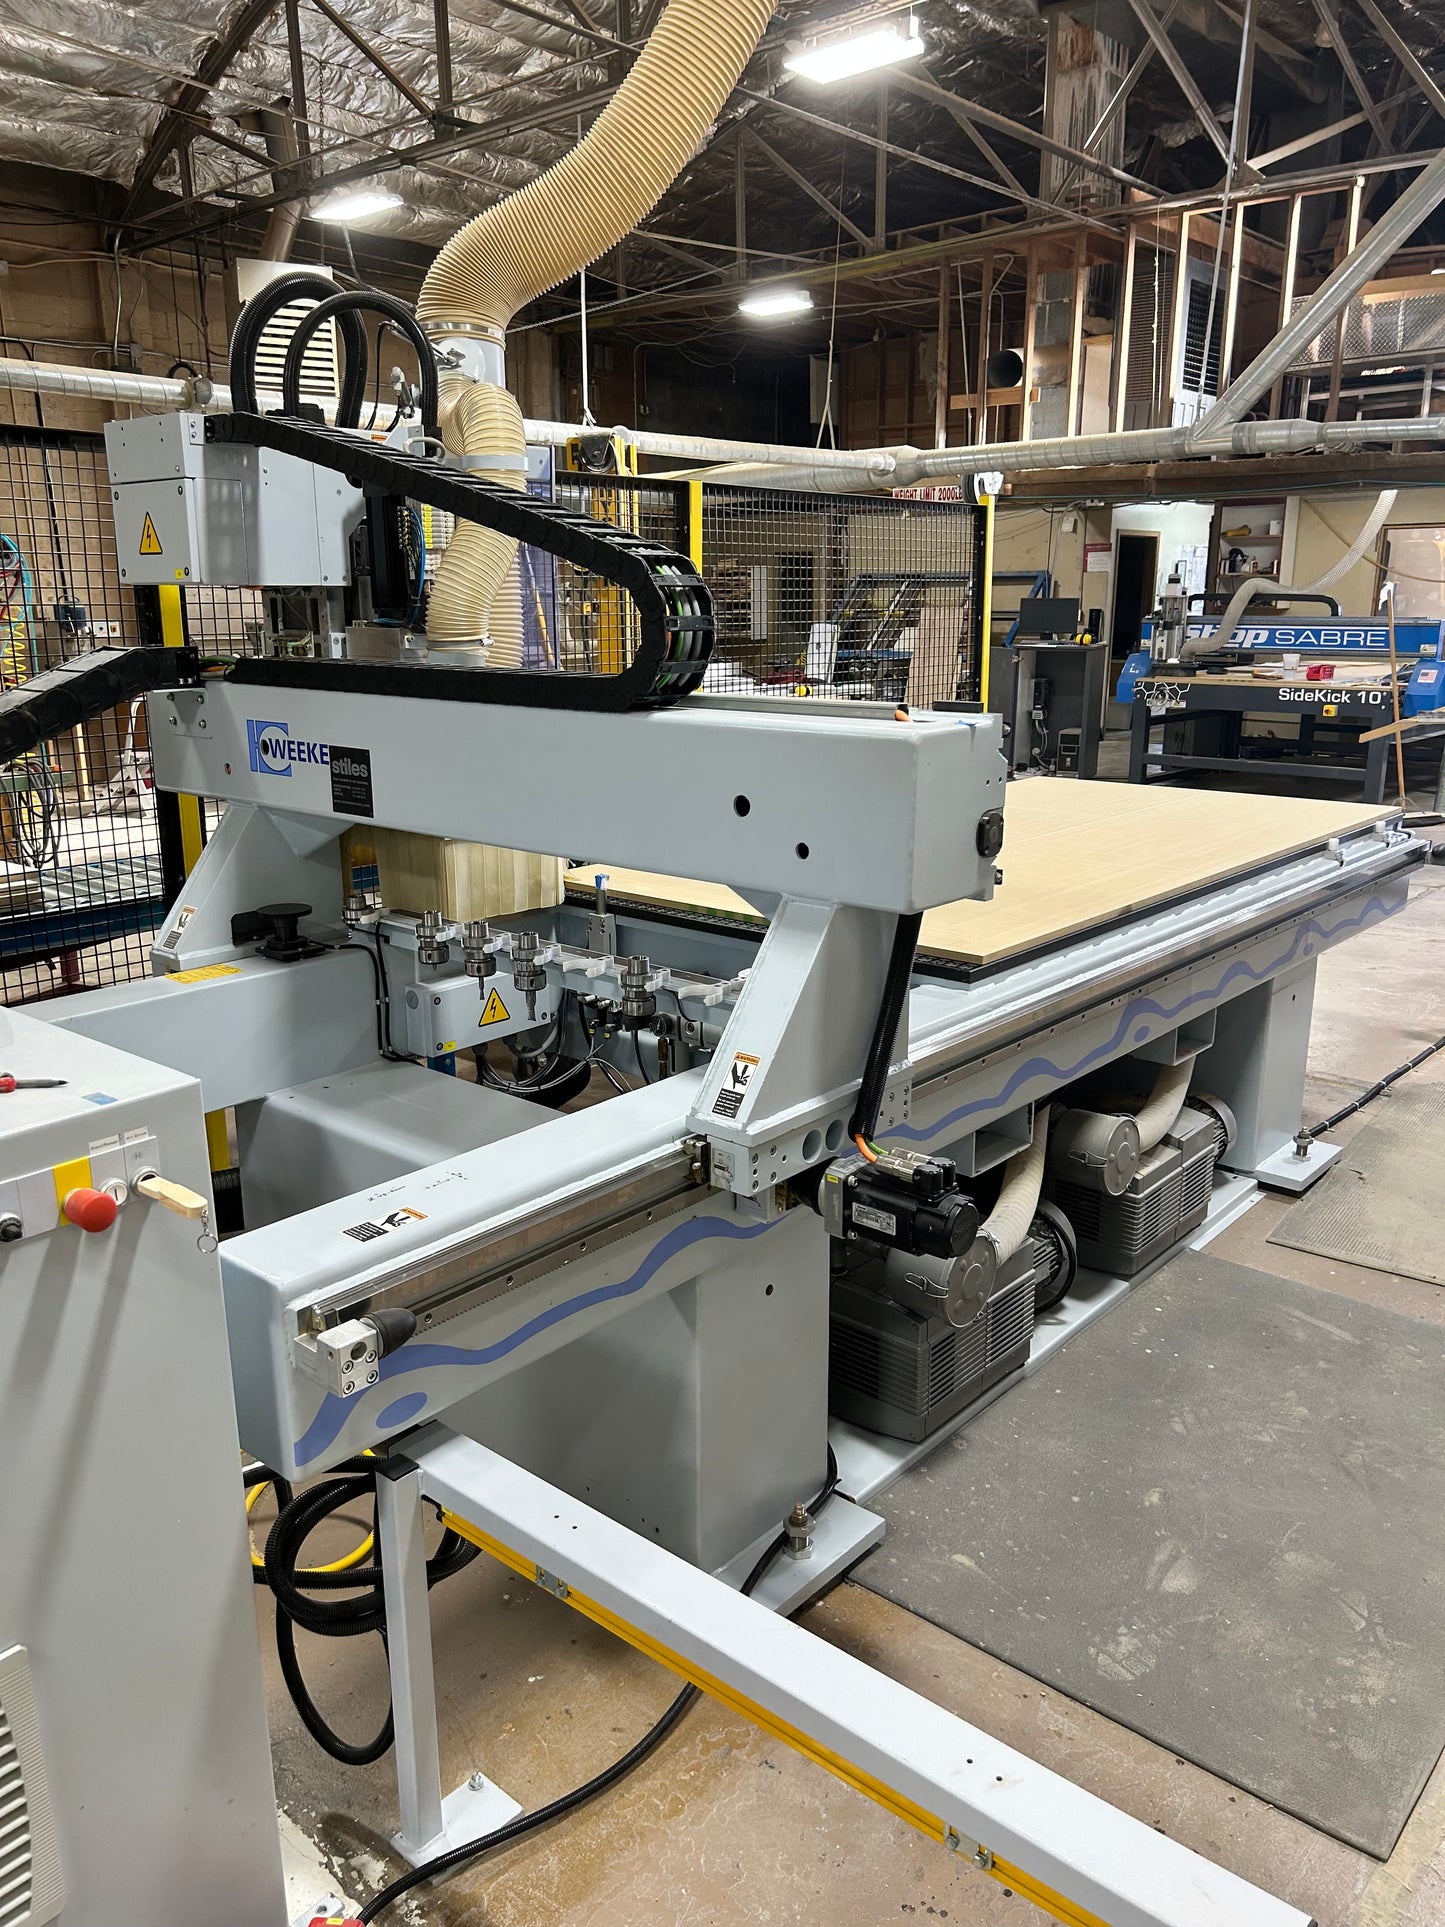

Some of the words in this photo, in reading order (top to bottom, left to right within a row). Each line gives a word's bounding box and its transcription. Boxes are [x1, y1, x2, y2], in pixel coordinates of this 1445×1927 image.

[894, 489, 917, 499] WEIGHT
[919, 487, 936, 501] LIMIT
[1275, 629, 1387, 647] SABRE
[1278, 688, 1351, 704] SideKick
[268, 738, 330, 765] WEEKE
[332, 757, 369, 777] stiles
